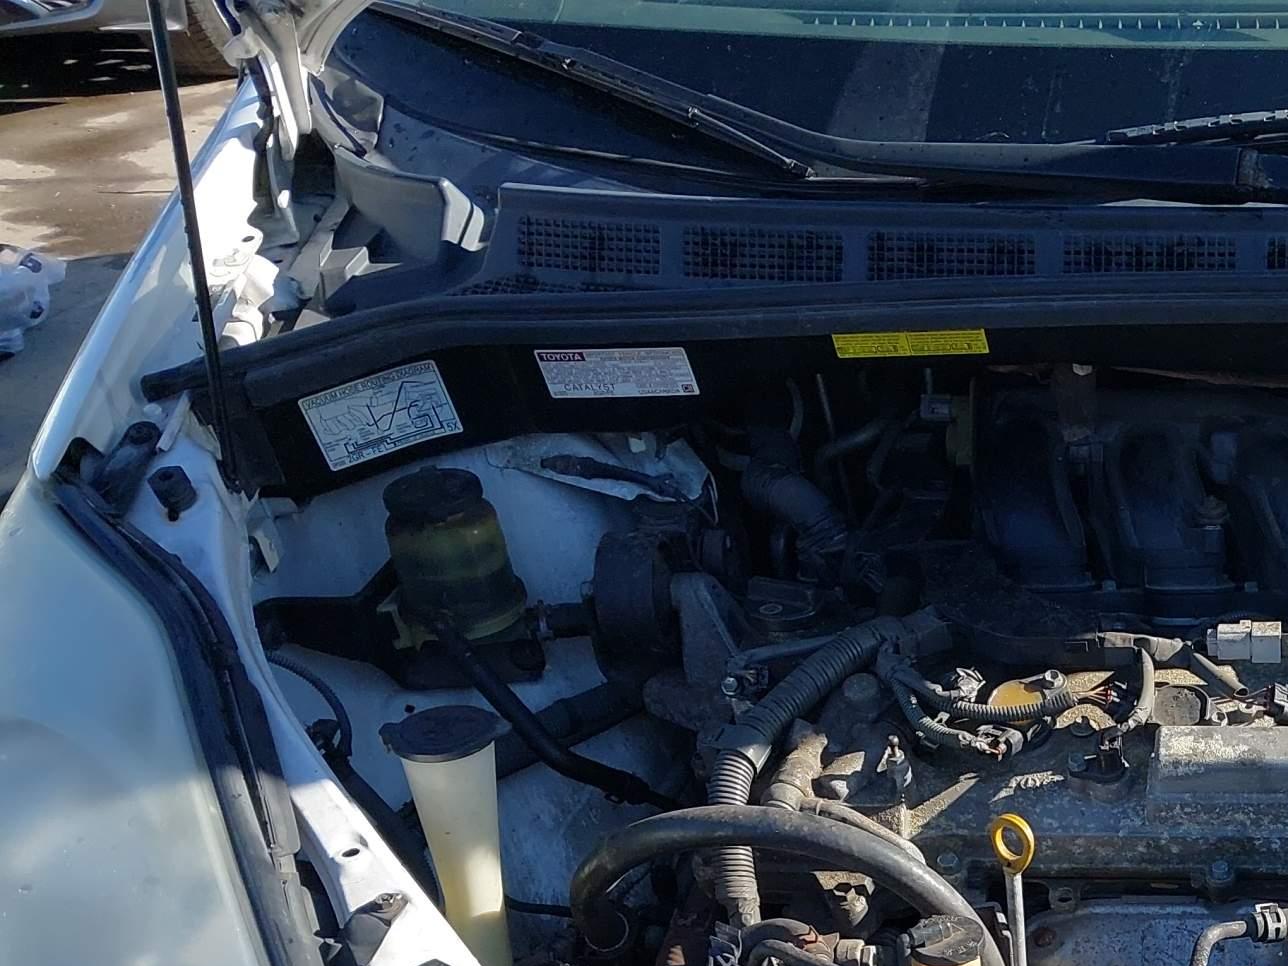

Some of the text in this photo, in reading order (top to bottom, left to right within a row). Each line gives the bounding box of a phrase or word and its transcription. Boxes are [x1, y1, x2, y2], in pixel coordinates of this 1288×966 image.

[540, 352, 582, 361] TOYOTA
[304, 390, 338, 409] VACUUM
[396, 362, 432, 380] DIAGRAM
[564, 383, 616, 392] CATALYST
